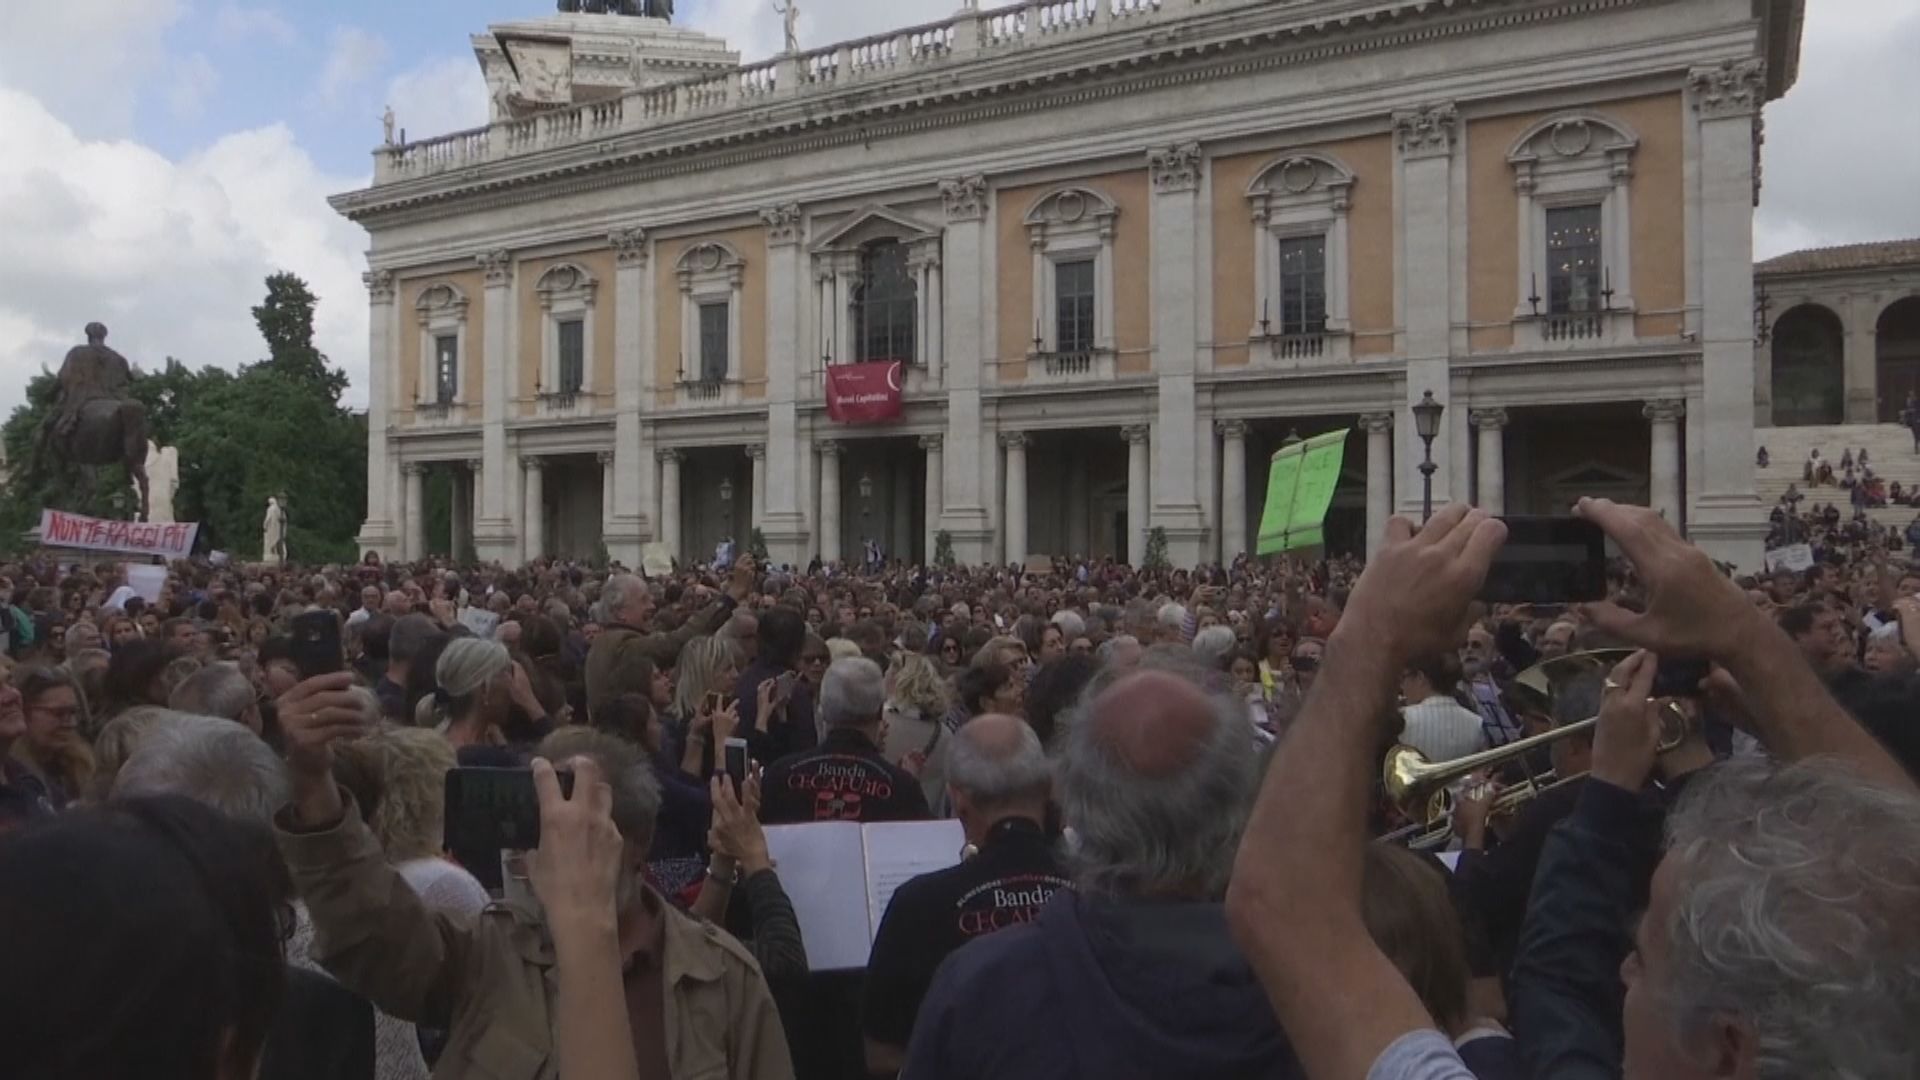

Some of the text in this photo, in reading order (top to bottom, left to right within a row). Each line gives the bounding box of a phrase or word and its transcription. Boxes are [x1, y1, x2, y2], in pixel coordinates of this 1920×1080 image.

[47, 511, 80, 544] NUN
[82, 521, 103, 544] TE
[106, 522, 161, 548] RAGGI
[818, 762, 866, 778] Banda
[994, 884, 1054, 908] Banda
[959, 907, 1041, 934] CECAF
